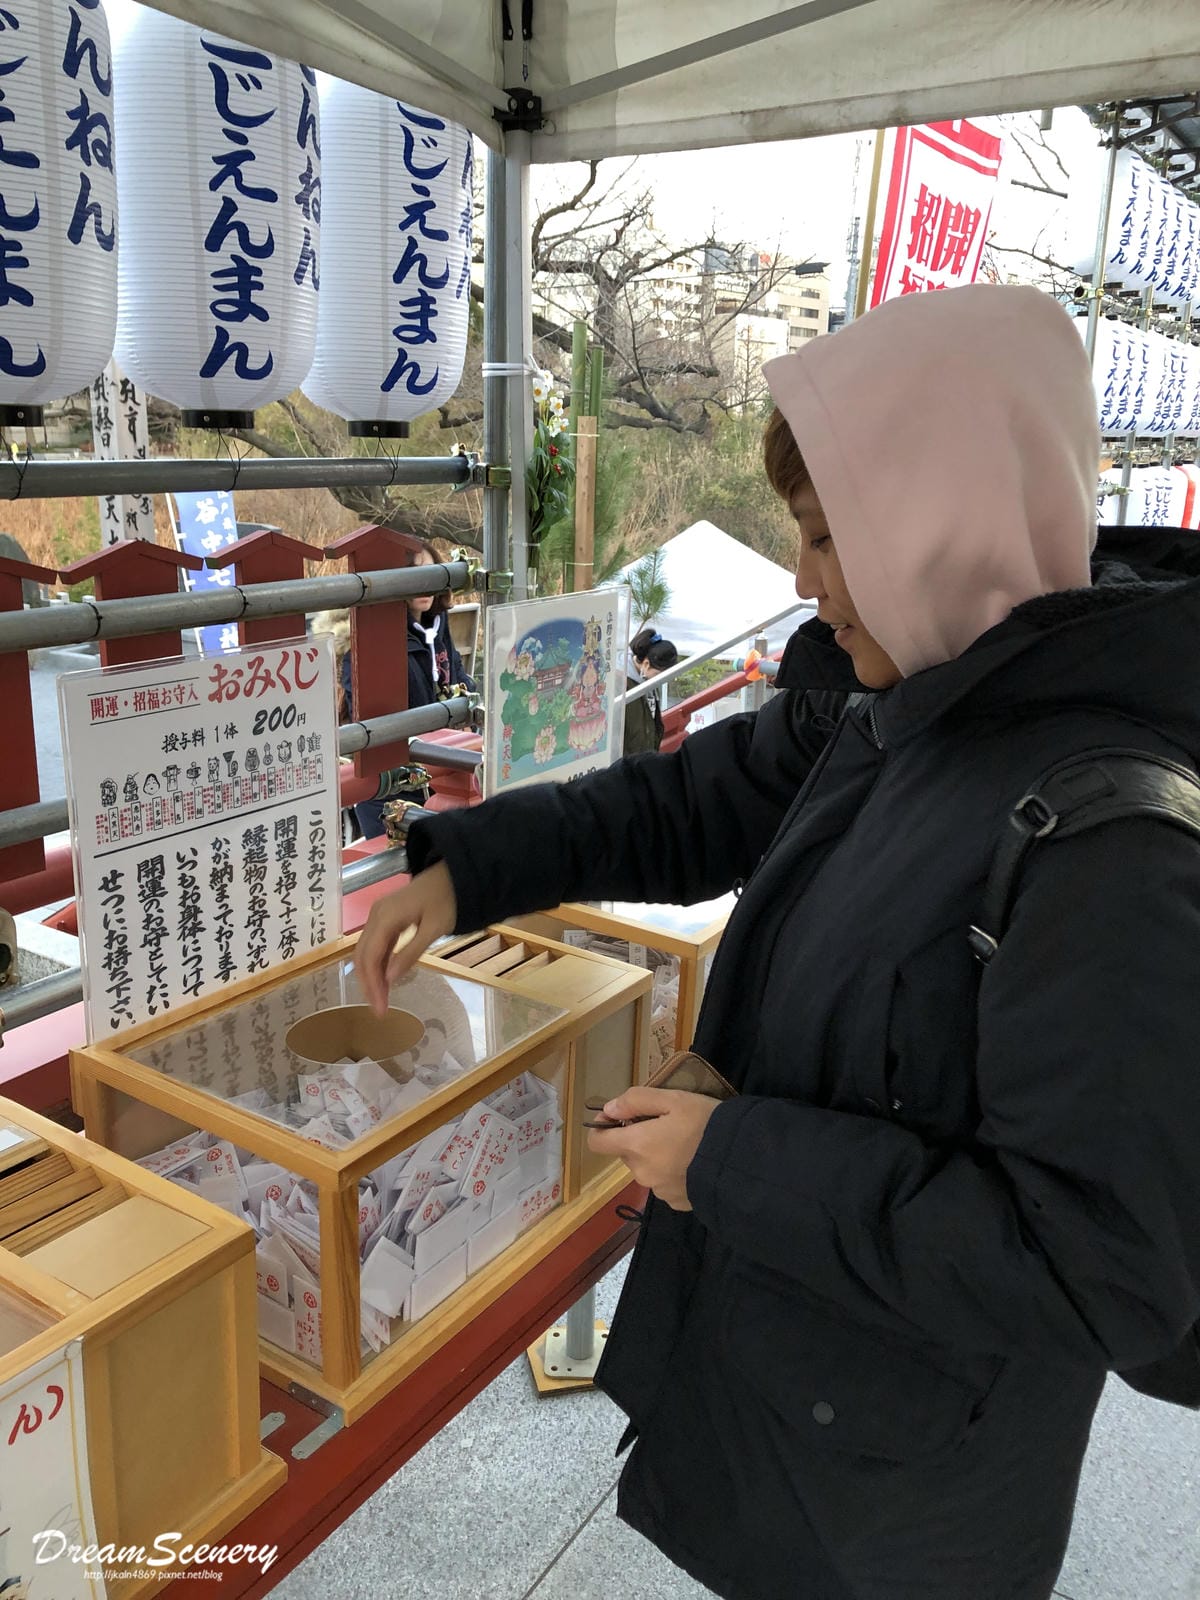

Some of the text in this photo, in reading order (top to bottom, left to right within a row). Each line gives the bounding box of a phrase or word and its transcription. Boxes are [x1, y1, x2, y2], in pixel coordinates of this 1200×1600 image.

[208, 647, 320, 704] おみくじ
[252, 704, 306, 736] 200円
[176, 847, 206, 997] いつもお身体につけて
[274, 815, 299, 960] 開運を招く十二体の
[307, 810, 326, 947] このおみくじには
